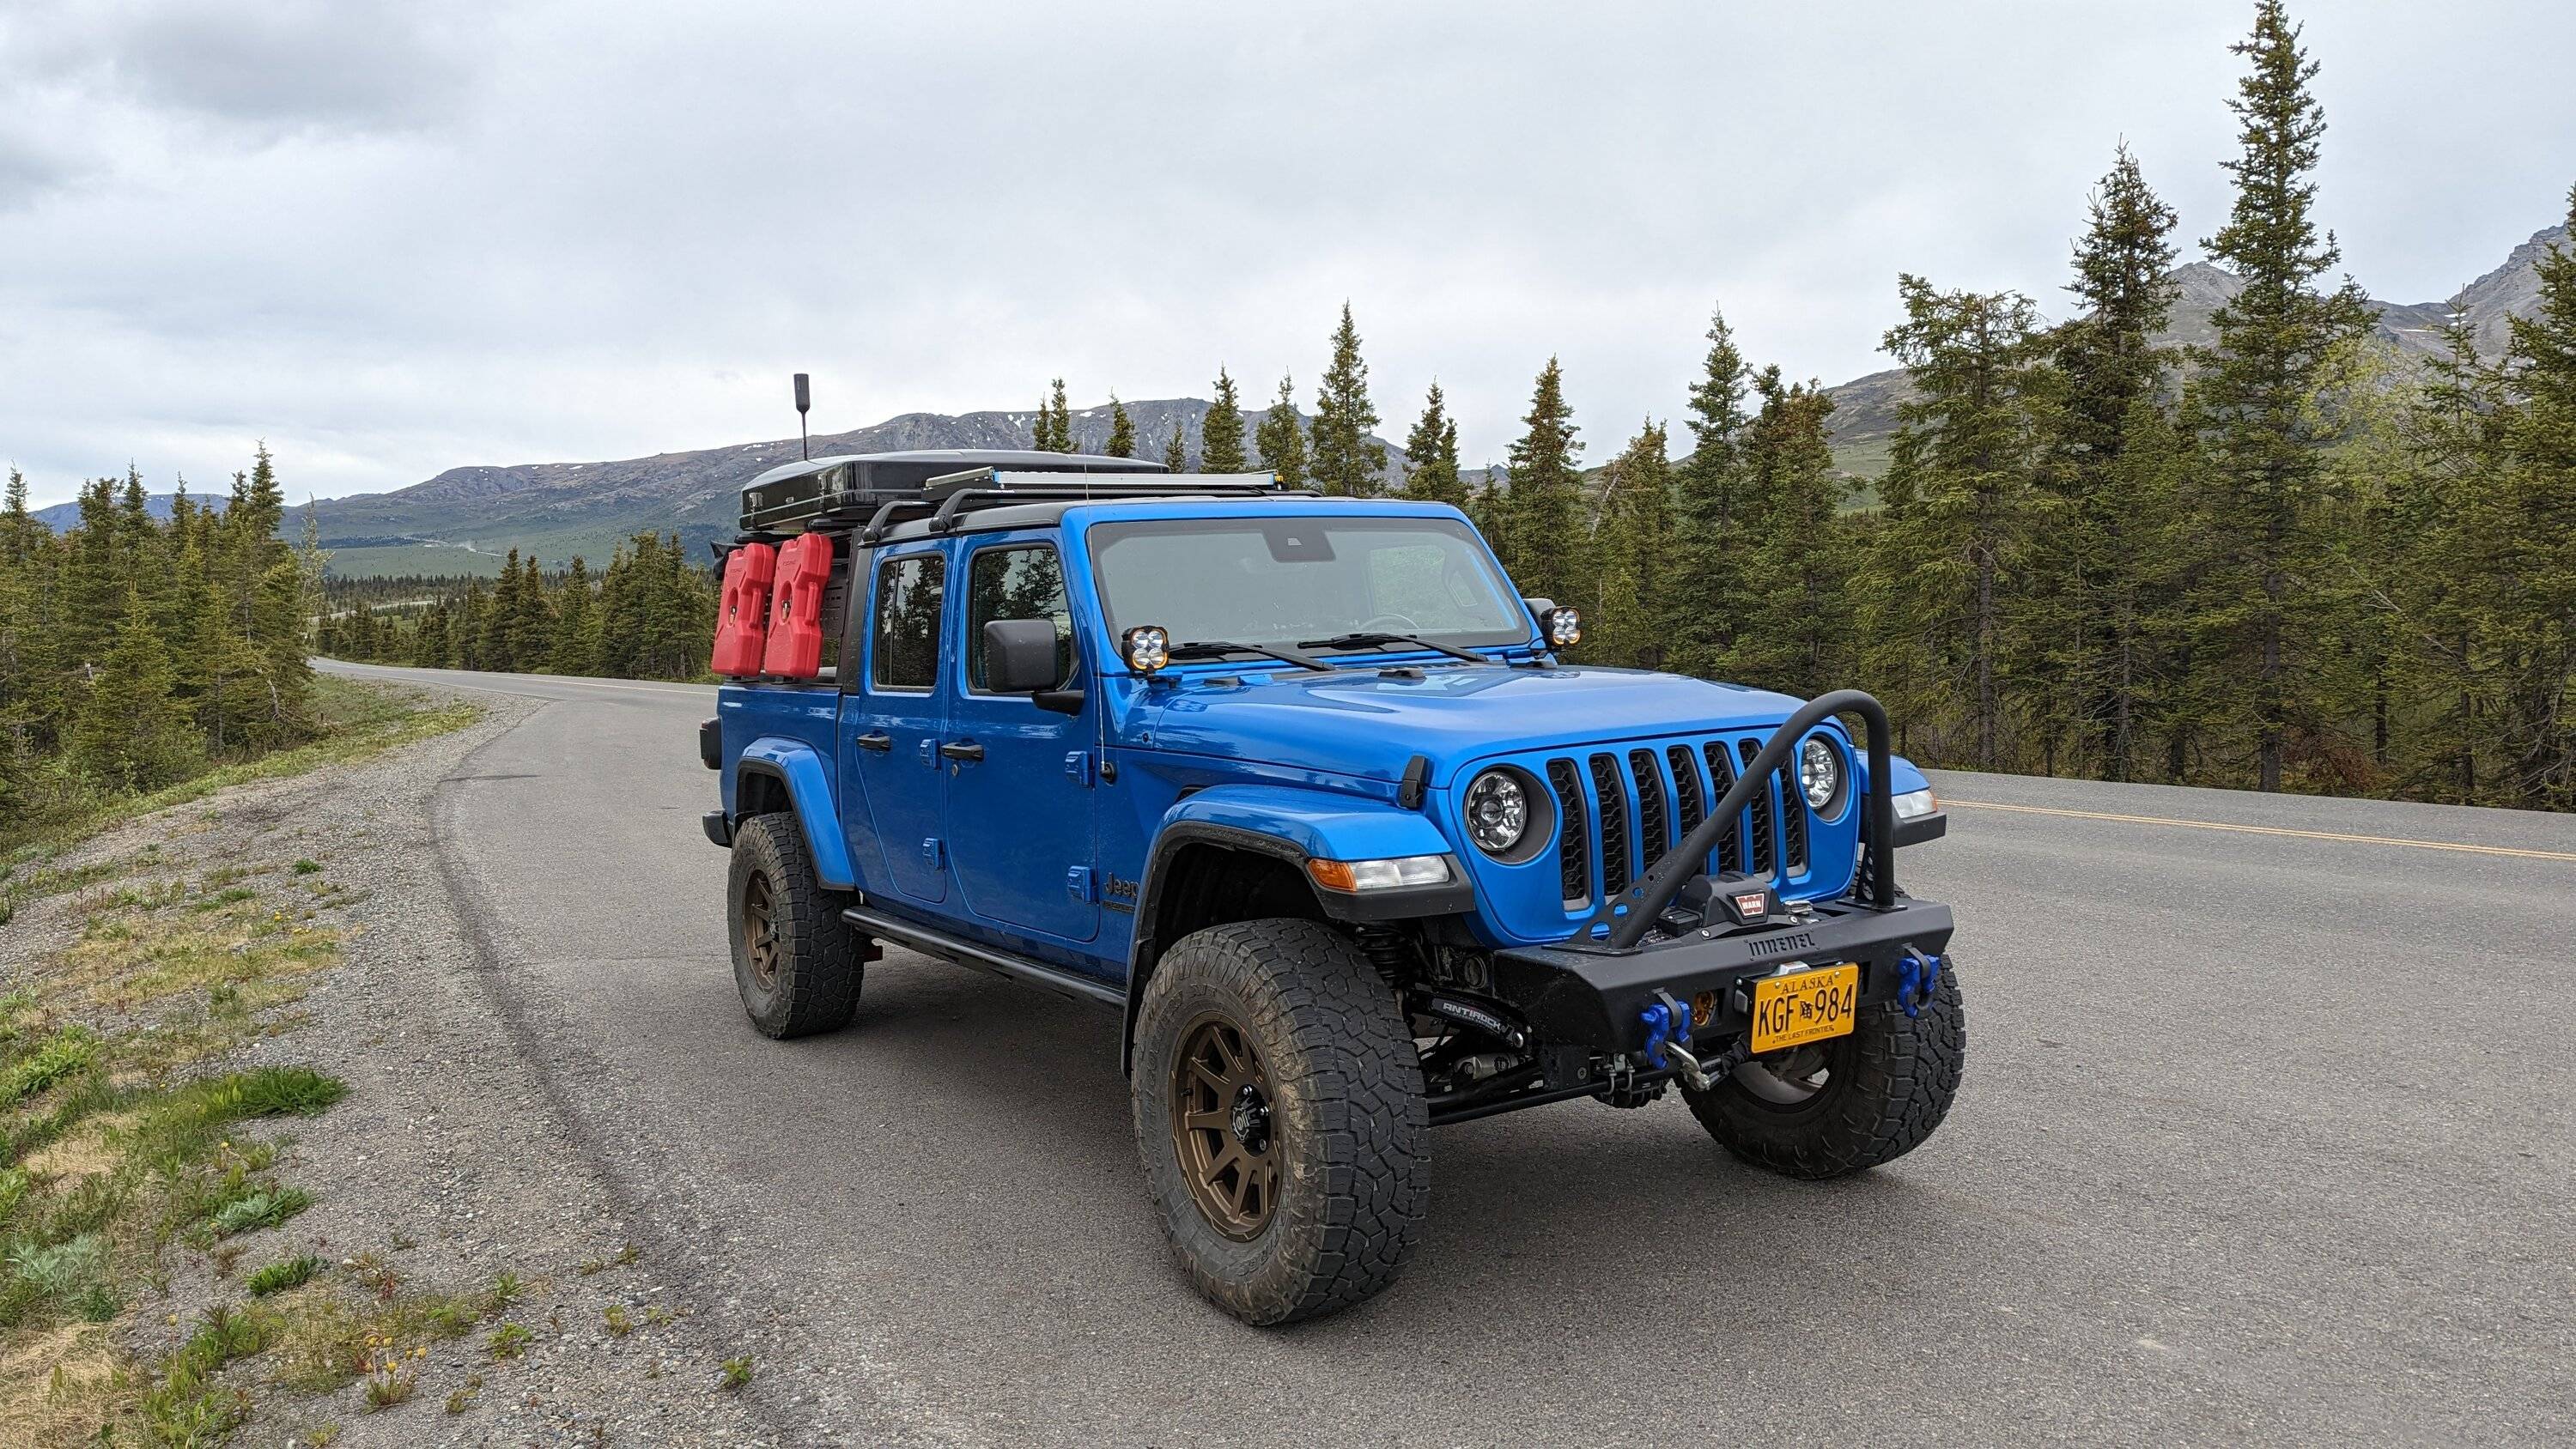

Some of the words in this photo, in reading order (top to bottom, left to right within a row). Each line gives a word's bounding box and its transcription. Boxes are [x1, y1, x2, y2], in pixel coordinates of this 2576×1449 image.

[1104, 872, 1139, 898] Jeep
[1742, 900, 1761, 910] WARN
[1780, 975, 1834, 994] ALASKA
[1443, 1003, 1501, 1030] ANTIROCK
[1758, 994, 1799, 1037] KGF
[1814, 984, 1853, 1024] 984
[1789, 1031, 1804, 1040] LAST
